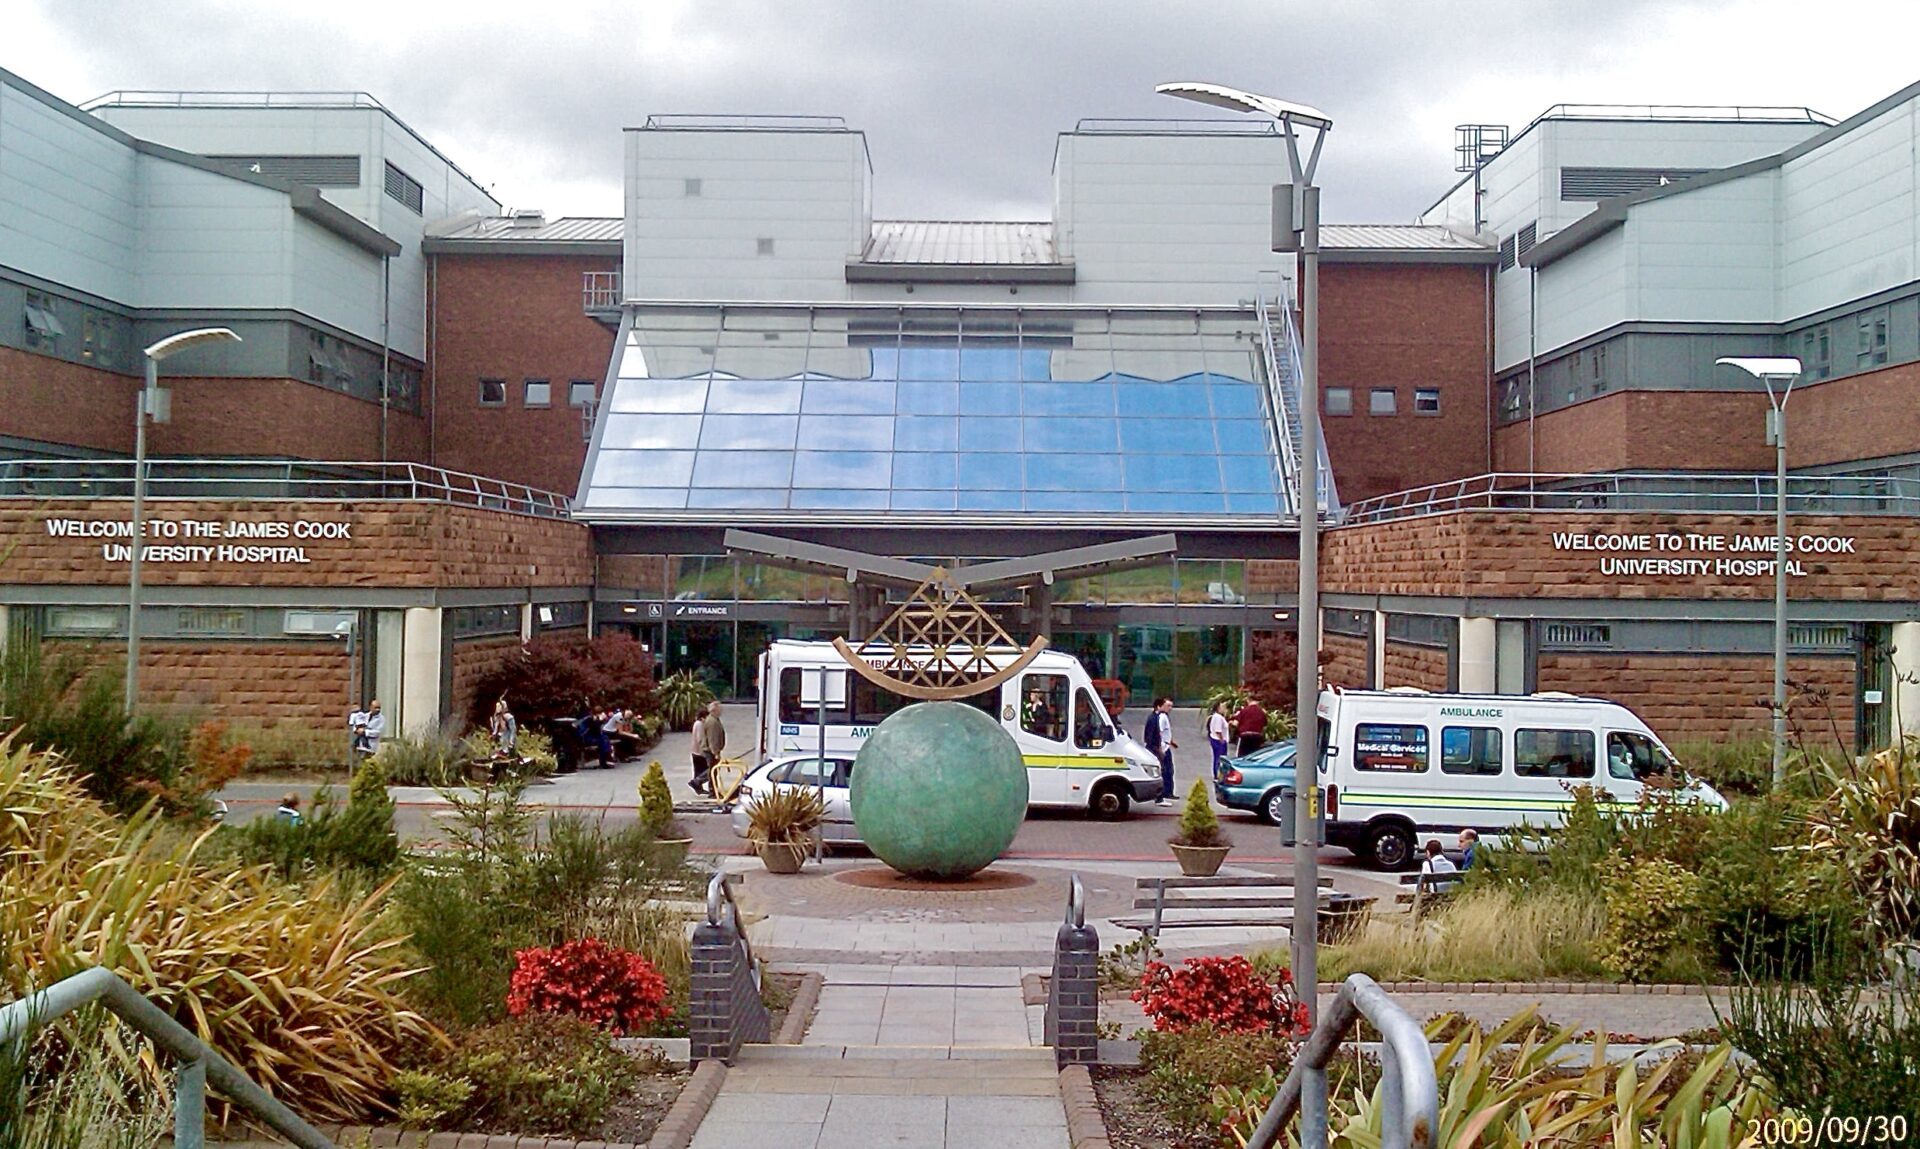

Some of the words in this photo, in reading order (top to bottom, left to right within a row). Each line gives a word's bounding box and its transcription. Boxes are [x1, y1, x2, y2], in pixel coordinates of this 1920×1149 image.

[148, 520, 178, 537] TO
[180, 520, 221, 537] THE
[223, 521, 290, 538] JAMES
[293, 520, 351, 539] COOK
[1552, 532, 1651, 551] WELCOME
[1655, 533, 1683, 551] TO
[1685, 534, 1725, 551] THE
[1728, 534, 1794, 552] JAMES
[1798, 534, 1855, 553] COOK
[104, 543, 215, 562] UNVERSITY
[218, 544, 311, 563] HOSPITAL
[1601, 557, 1711, 575] UNIVERSITY
[1715, 558, 1808, 576] HOSPIAL
[688, 607, 728, 615] ENTRANCE
[1440, 707, 1503, 718] AMBULANCE
[1357, 743, 1389, 752] Medical
